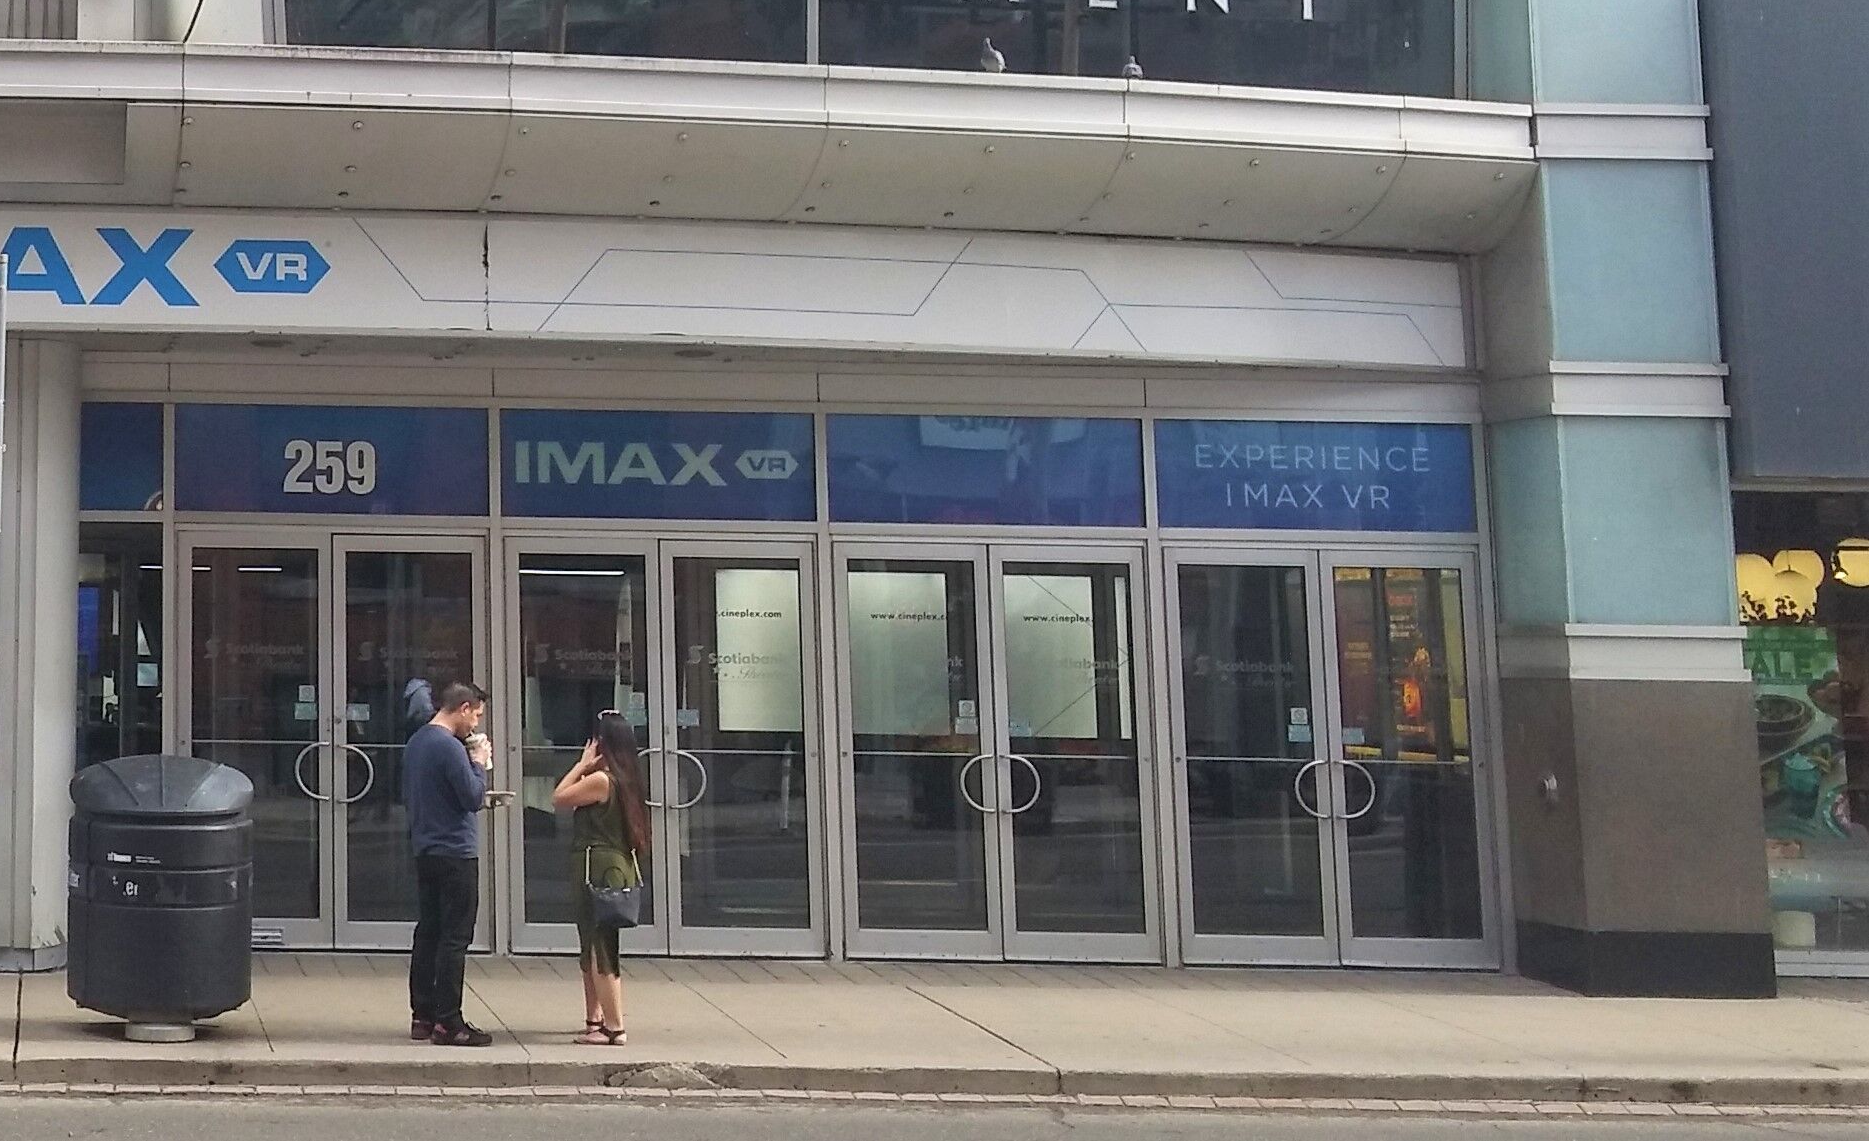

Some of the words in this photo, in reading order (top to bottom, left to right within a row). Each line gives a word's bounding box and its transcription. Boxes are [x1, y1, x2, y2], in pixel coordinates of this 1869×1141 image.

[235, 251, 309, 282] VR
[283, 440, 377, 495] 259
[514, 441, 728, 487] IMAX
[746, 455, 786, 472] VR
[1195, 444, 1431, 473] EXPERIENCE
[1226, 482, 1324, 509] IMAX
[1341, 483, 1391, 510] VR
[716, 609, 782, 619] .cineplex.com
[870, 611, 948, 622] www.cineplex.c
[1023, 613, 1094, 624] www.cineplex.
[708, 651, 786, 665] Scotiaban
[1750, 650, 1813, 678] ALE
